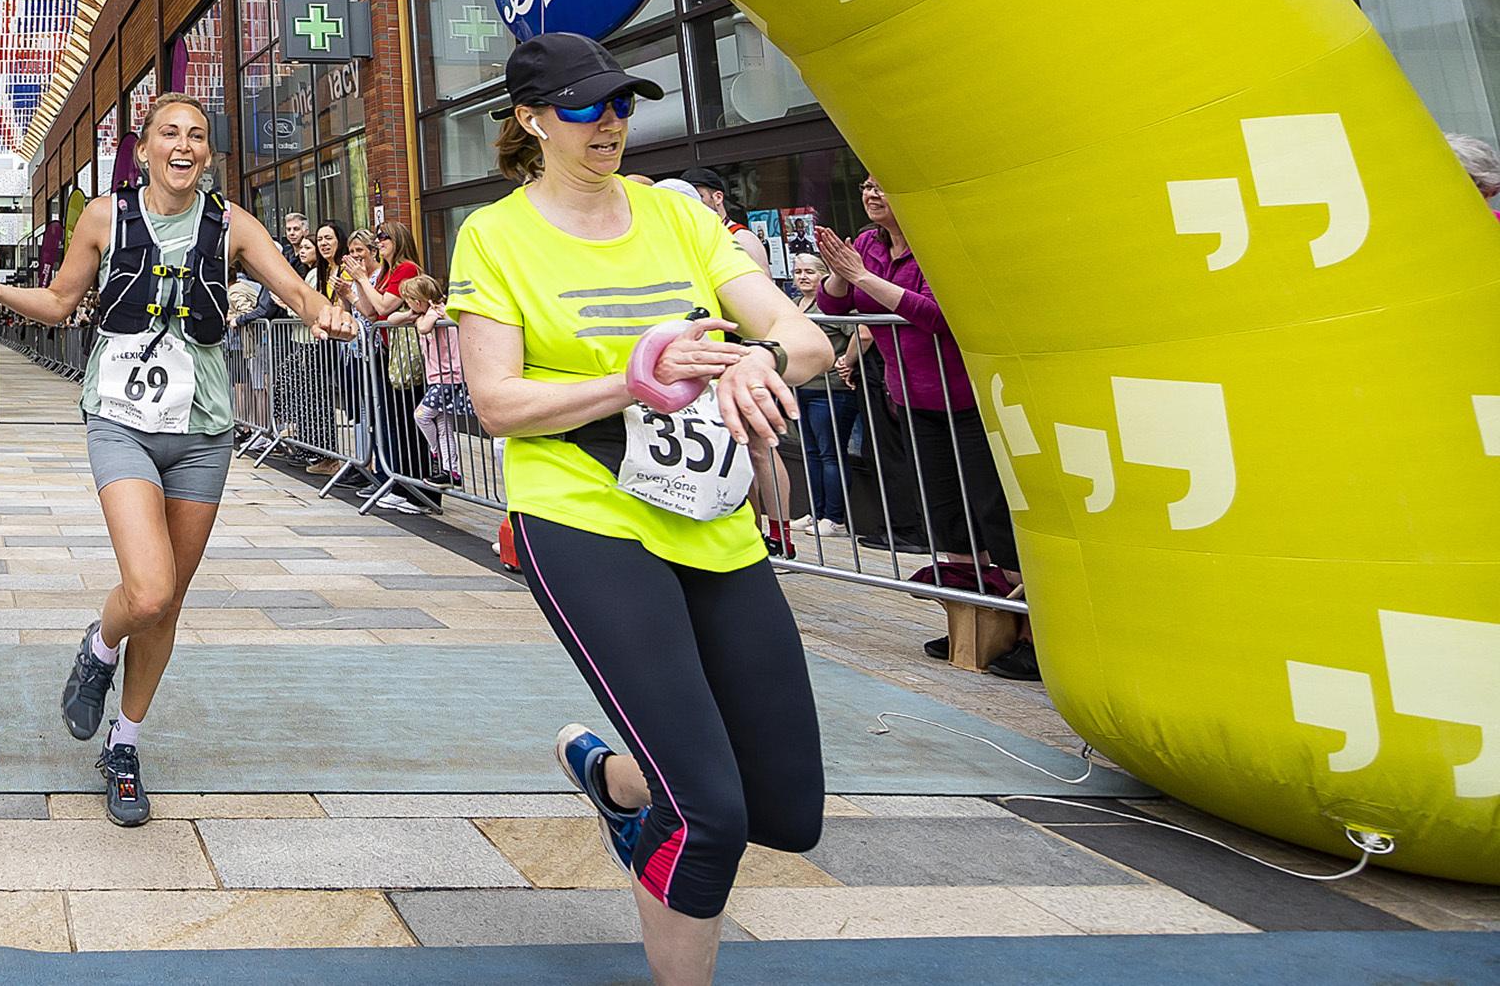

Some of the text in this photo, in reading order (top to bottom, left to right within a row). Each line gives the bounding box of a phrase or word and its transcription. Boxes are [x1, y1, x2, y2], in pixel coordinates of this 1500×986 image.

[124, 365, 169, 404] 69
[642, 411, 739, 479] 357
[636, 472, 698, 494] everyone
[662, 487, 697, 503] ACTIVE
